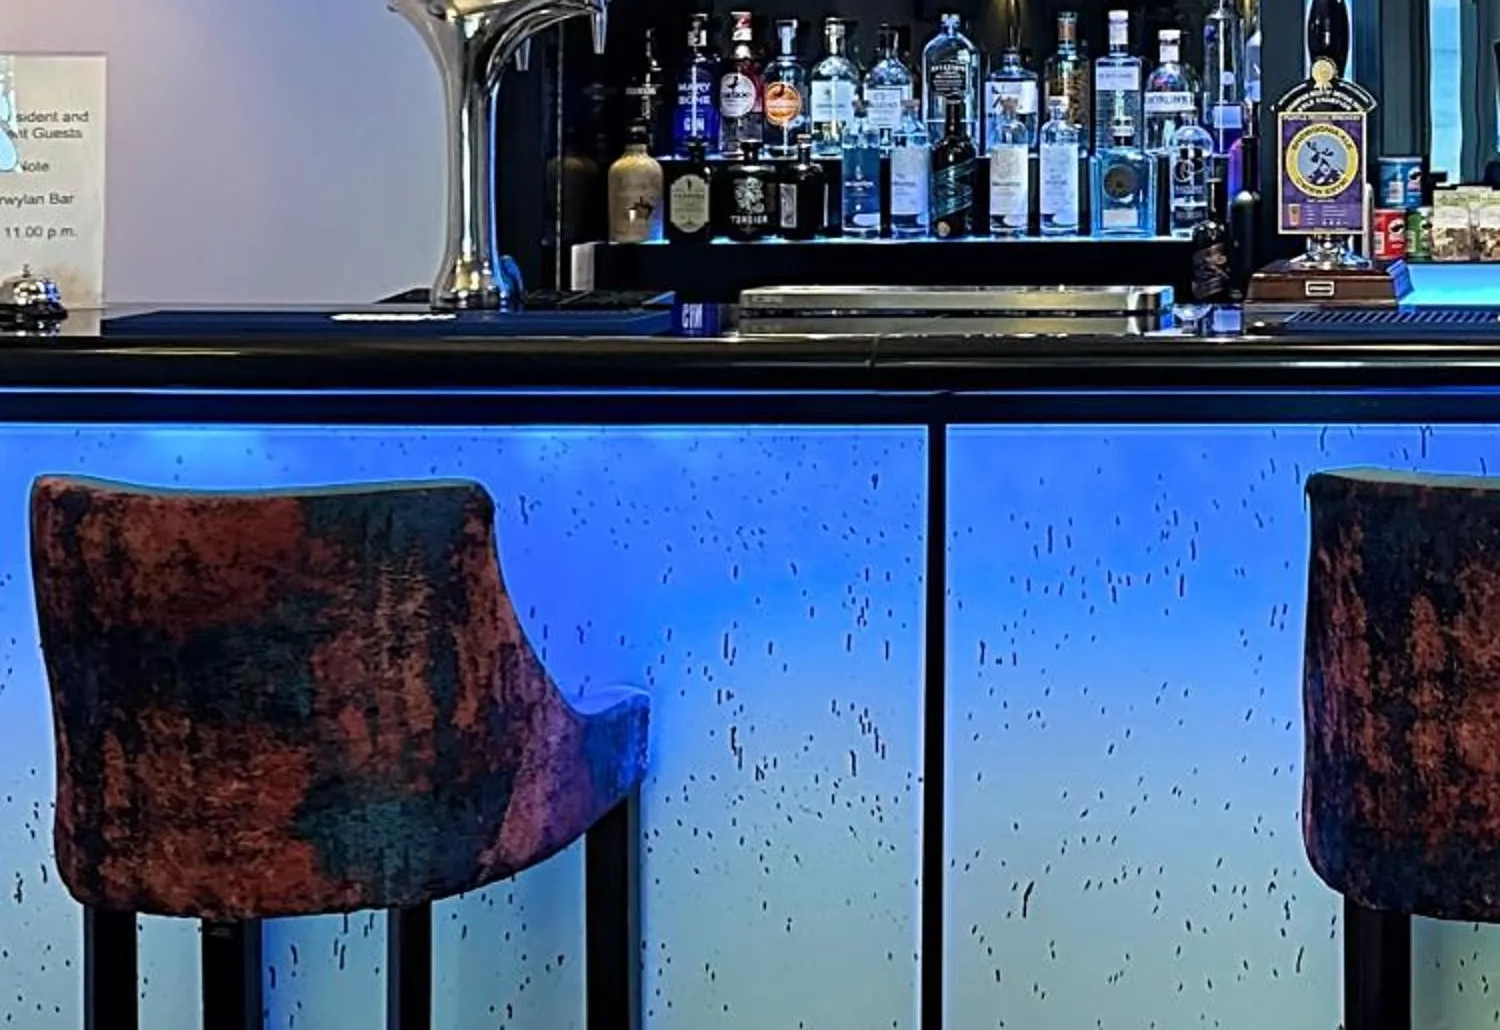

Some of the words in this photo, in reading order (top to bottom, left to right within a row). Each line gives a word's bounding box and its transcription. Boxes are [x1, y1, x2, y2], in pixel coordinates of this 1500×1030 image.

[15, 110, 57, 123] sident
[61, 110, 89, 123] and
[32, 127, 83, 139] Guests
[0, 193, 45, 208] rwylan
[49, 193, 75, 205] Bar
